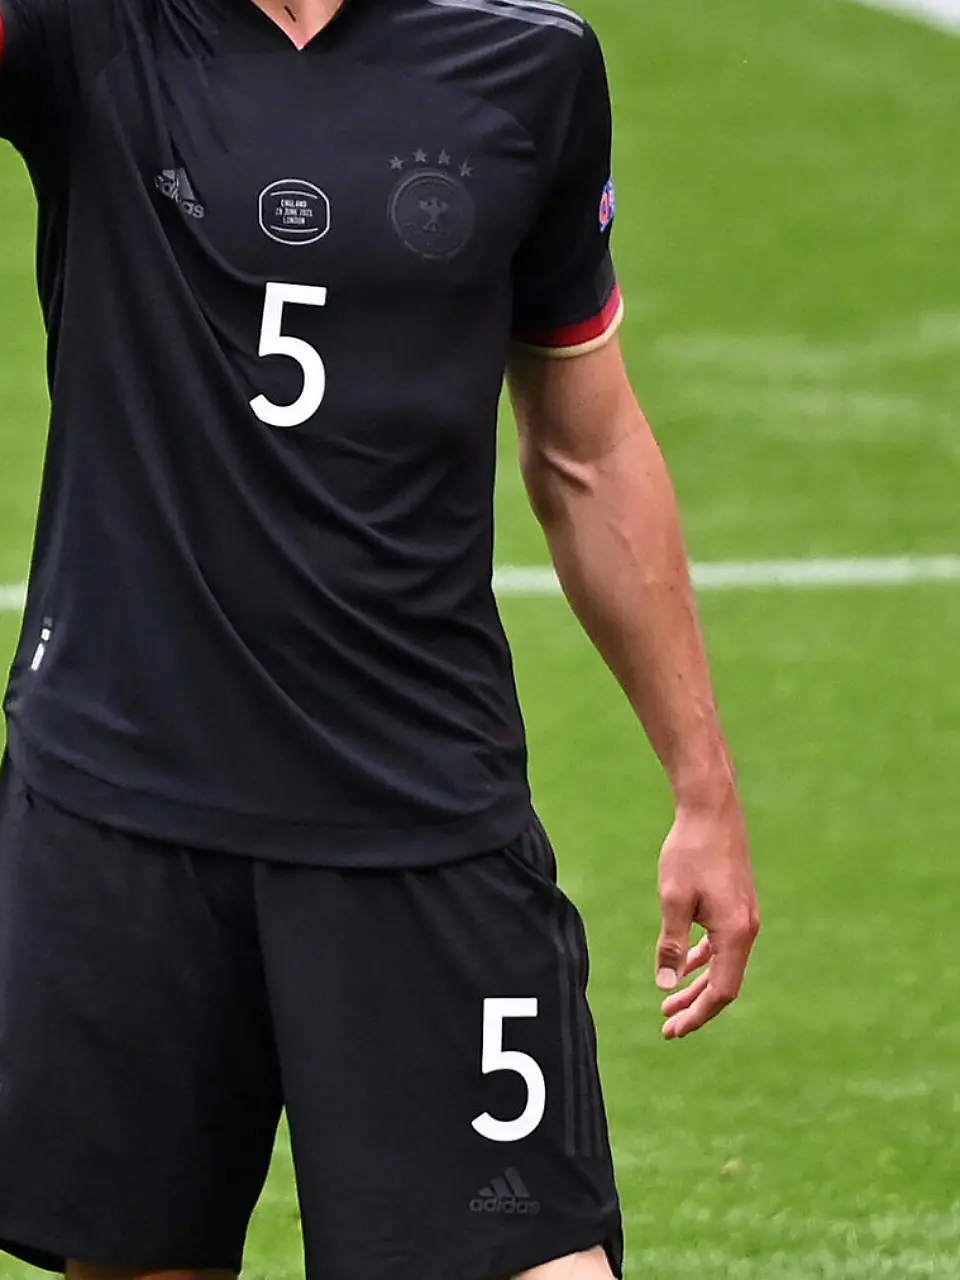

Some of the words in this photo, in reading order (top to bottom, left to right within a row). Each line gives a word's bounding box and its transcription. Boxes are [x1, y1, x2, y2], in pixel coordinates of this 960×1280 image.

[249, 281, 327, 427] 5
[471, 997, 546, 1142] 5
[468, 1197, 541, 1215] adidas
